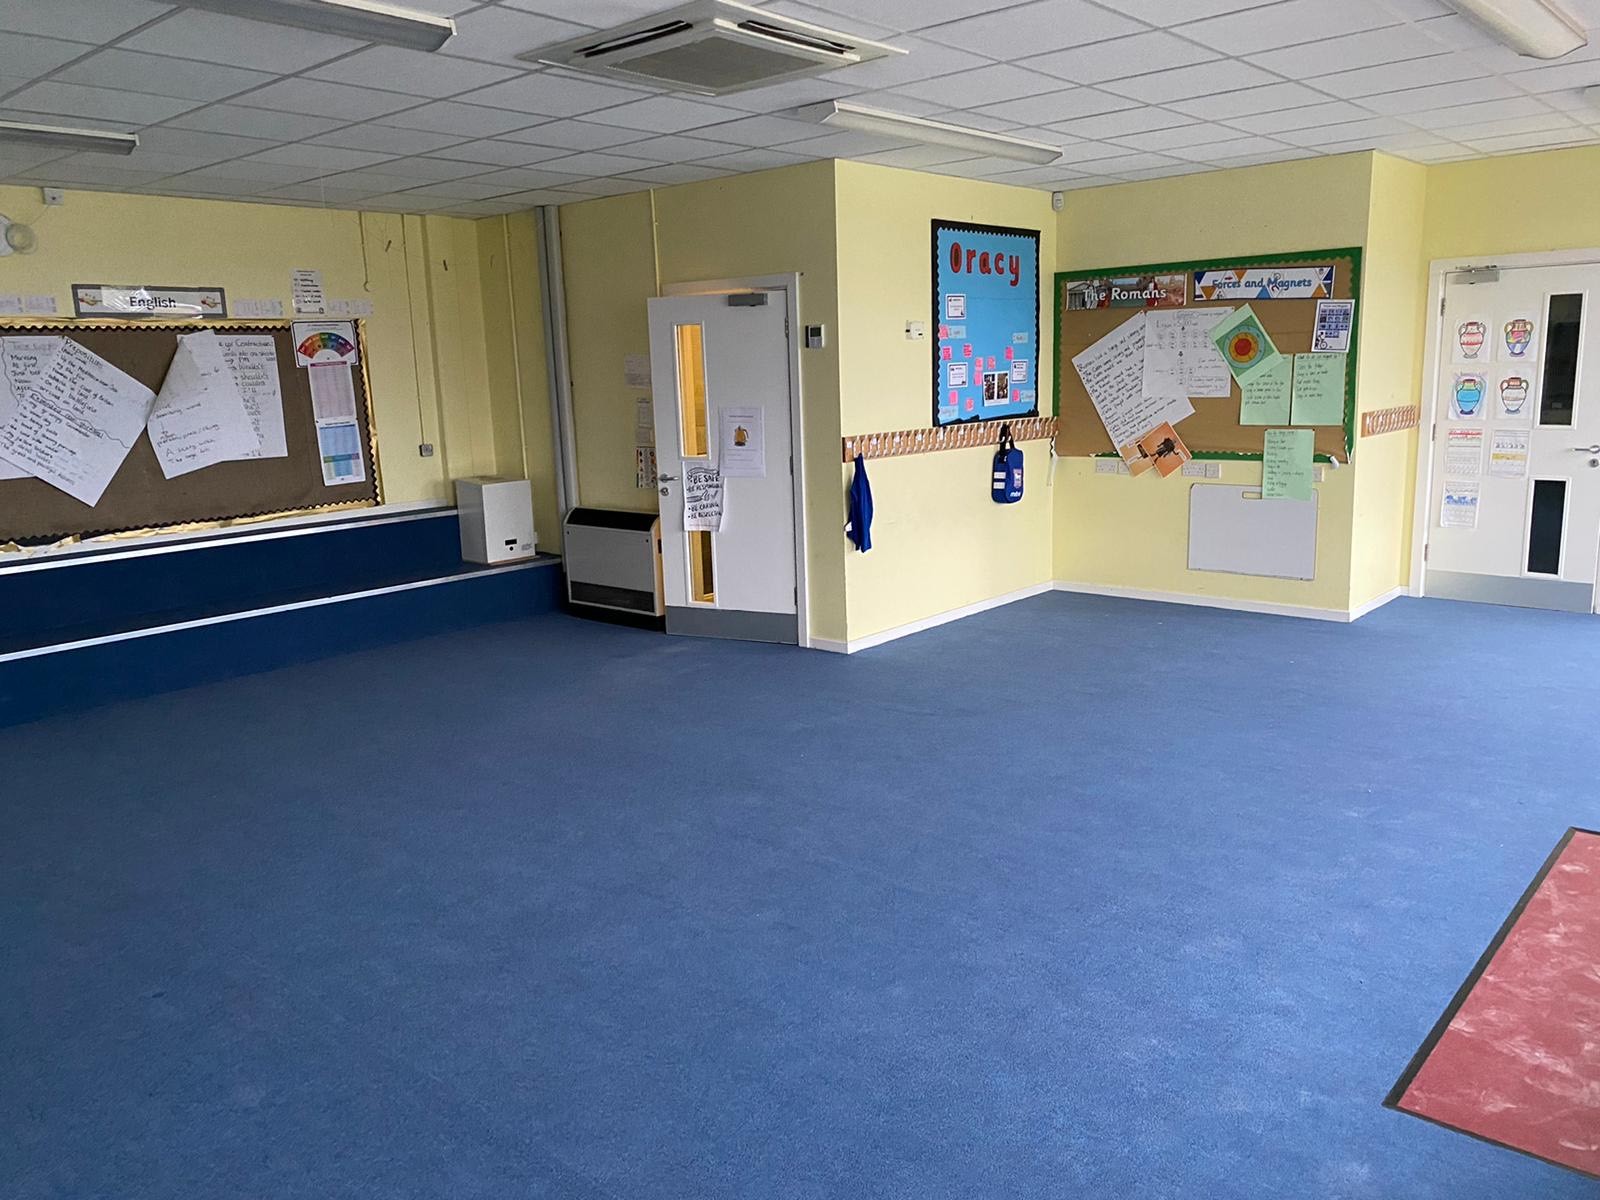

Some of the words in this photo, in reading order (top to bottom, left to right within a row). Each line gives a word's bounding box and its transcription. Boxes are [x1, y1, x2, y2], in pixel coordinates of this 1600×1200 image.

[950, 242, 1020, 287] Oracy
[1212, 278, 1242, 289] Forces
[1244, 278, 1265, 288] and
[1267, 277, 1312, 291] Magnets
[1082, 289, 1106, 302] The
[1111, 287, 1167, 300] Romans
[129, 296, 177, 310] English
